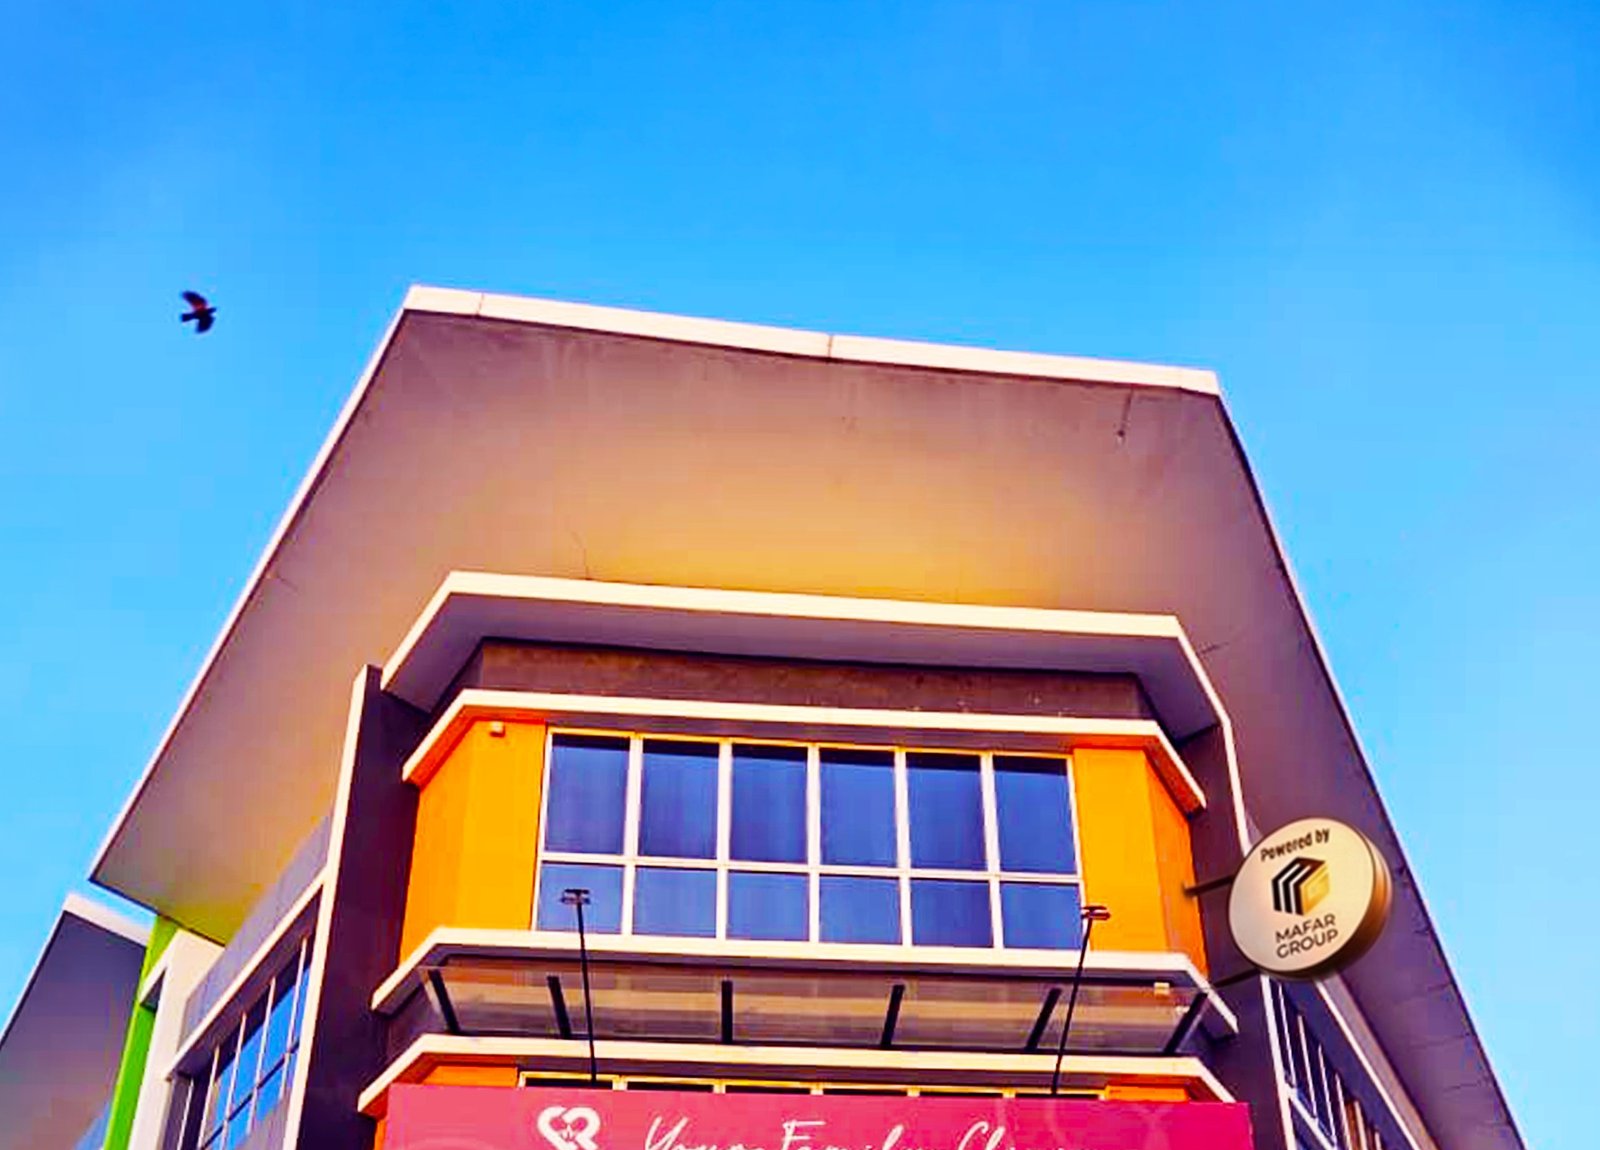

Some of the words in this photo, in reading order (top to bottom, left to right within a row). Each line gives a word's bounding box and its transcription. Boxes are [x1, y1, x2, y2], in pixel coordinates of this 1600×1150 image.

[1260, 832, 1313, 861] Powered
[1315, 828, 1330, 843] by
[1275, 914, 1336, 943] MAFAR
[1276, 929, 1338, 958] GROUP
